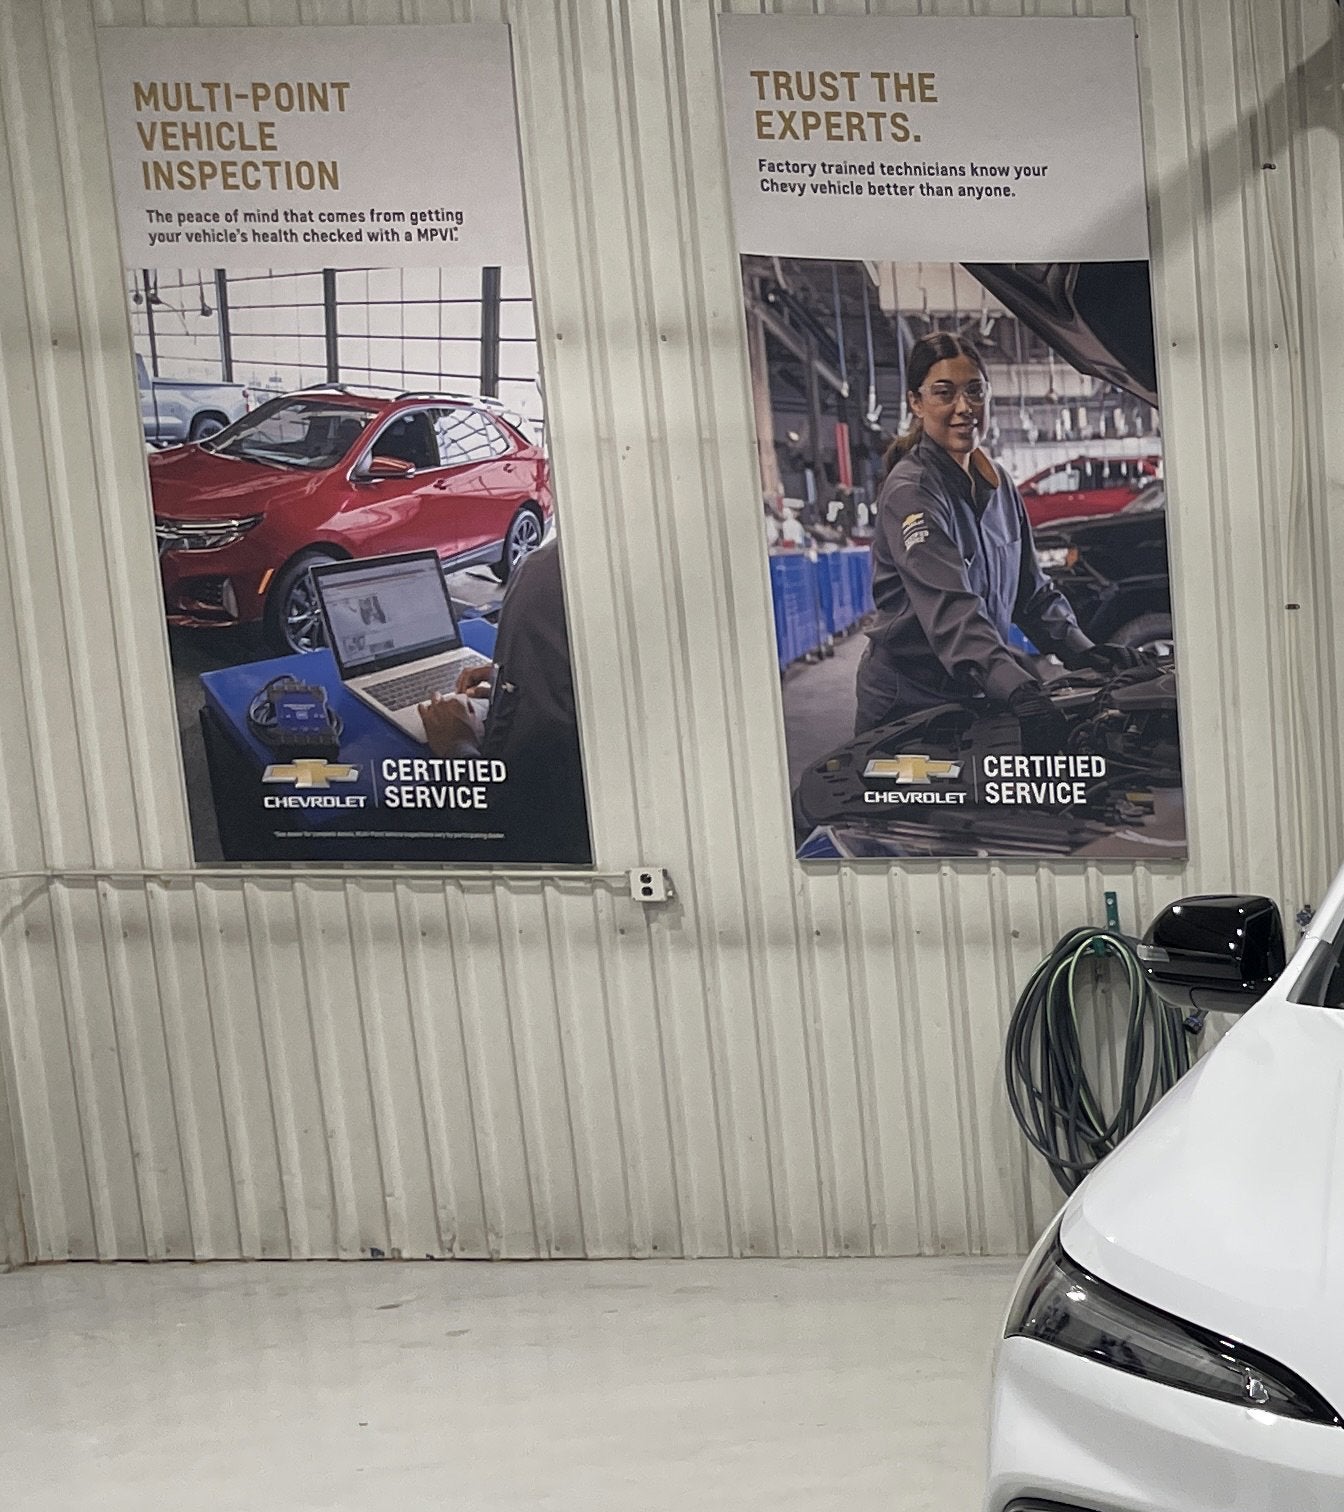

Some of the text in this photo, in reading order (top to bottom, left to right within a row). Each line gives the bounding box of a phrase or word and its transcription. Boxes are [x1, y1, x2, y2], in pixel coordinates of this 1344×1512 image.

[133, 82, 350, 112] MULTI-POINT
[750, 71, 938, 102] TRUST THE
[136, 121, 278, 151] VEHICLE
[755, 110, 921, 142] EXPERTS.
[142, 160, 339, 191] INSPECTION
[758, 158, 1048, 180] Factory trained technicians know your
[760, 178, 1016, 200] Chevy vehicle better than anyone.
[146, 208, 464, 226] The peace of mind that comes from getting
[148, 230, 181, 246] your
[185, 228, 249, 242] vehicle's
[252, 228, 298, 242] health
[303, 228, 363, 242] checked
[366, 227, 400, 242] with
[404, 231, 412, 241] a
[382, 758, 506, 782] CERTIFIED
[982, 755, 1106, 778] CERTIFIED
[263, 796, 367, 809] CHEVROLET
[384, 785, 488, 809] SERVICE
[863, 791, 967, 804] CHEVROLET
[984, 781, 1087, 804] SERVICE
